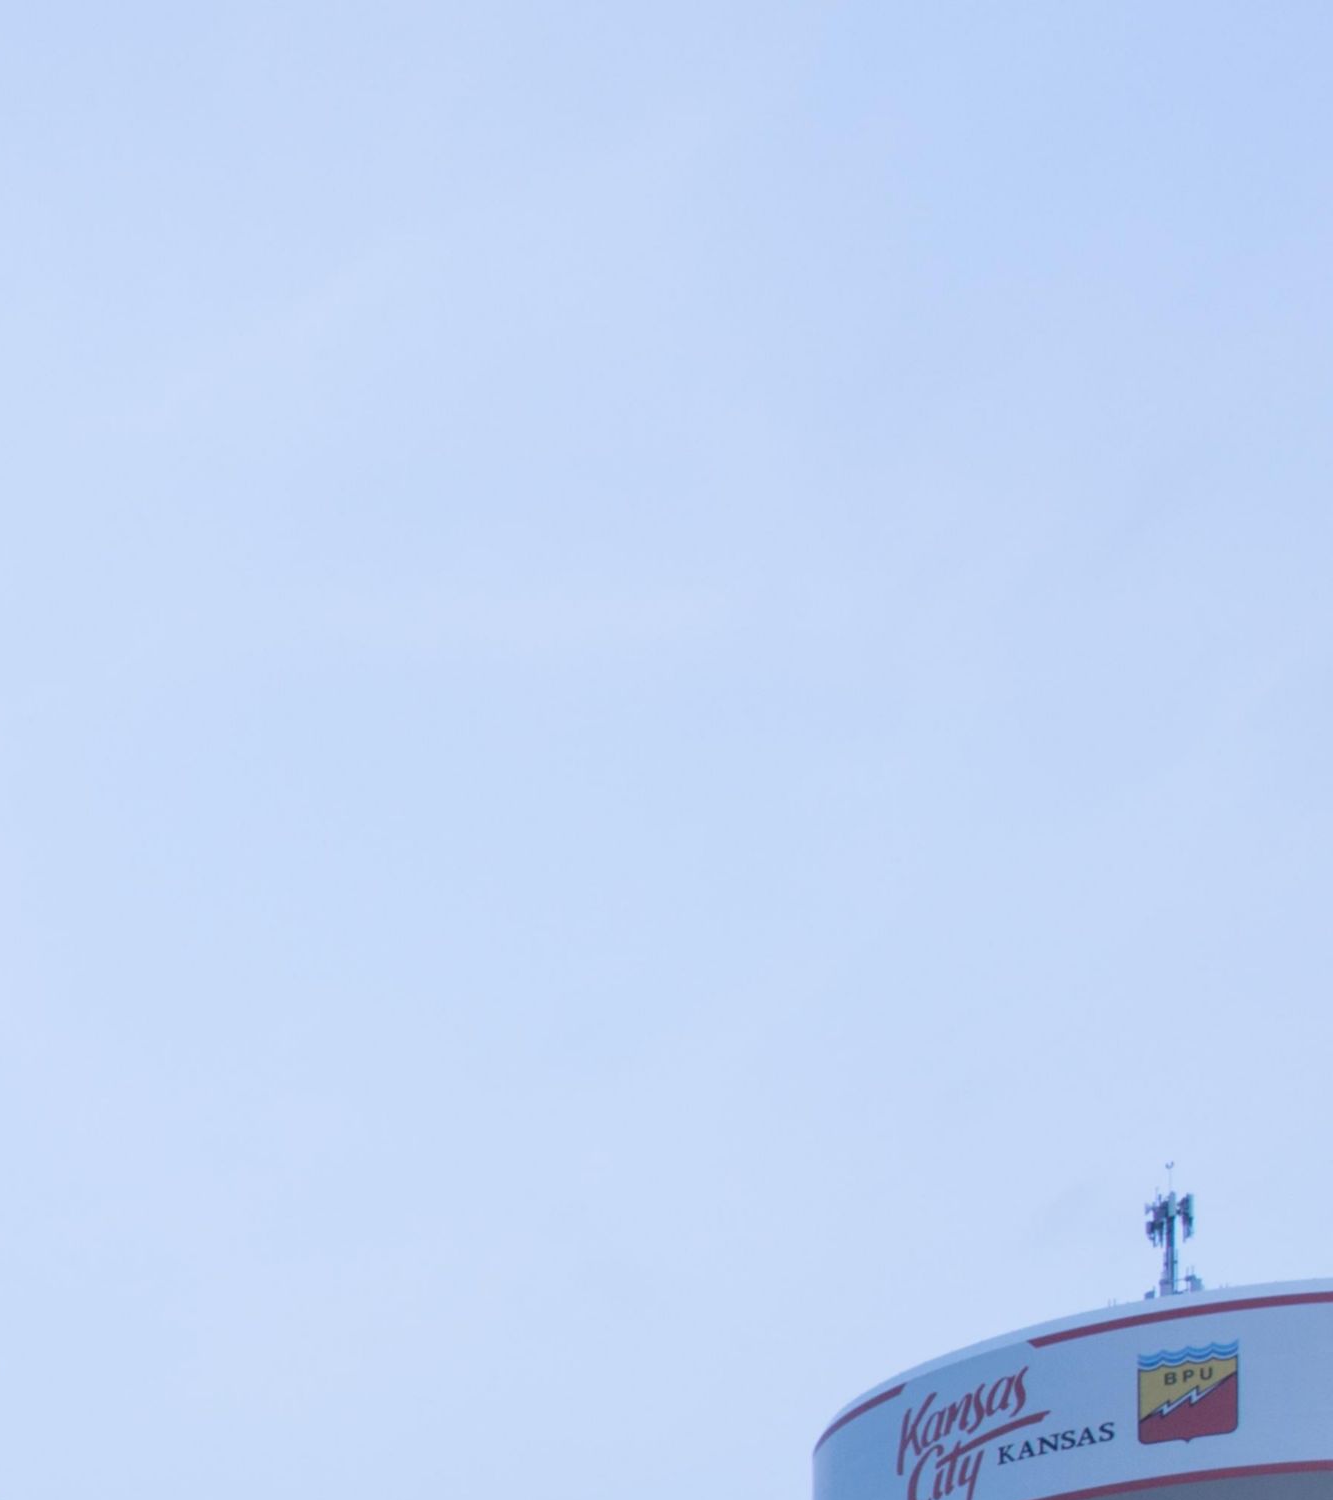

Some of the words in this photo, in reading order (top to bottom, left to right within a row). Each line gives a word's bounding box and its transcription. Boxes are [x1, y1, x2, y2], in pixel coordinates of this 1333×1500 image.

[1164, 1367, 1213, 1386] BPU
[897, 1366, 1029, 1476] Kansas
[997, 1421, 1115, 1466] KANSAS
